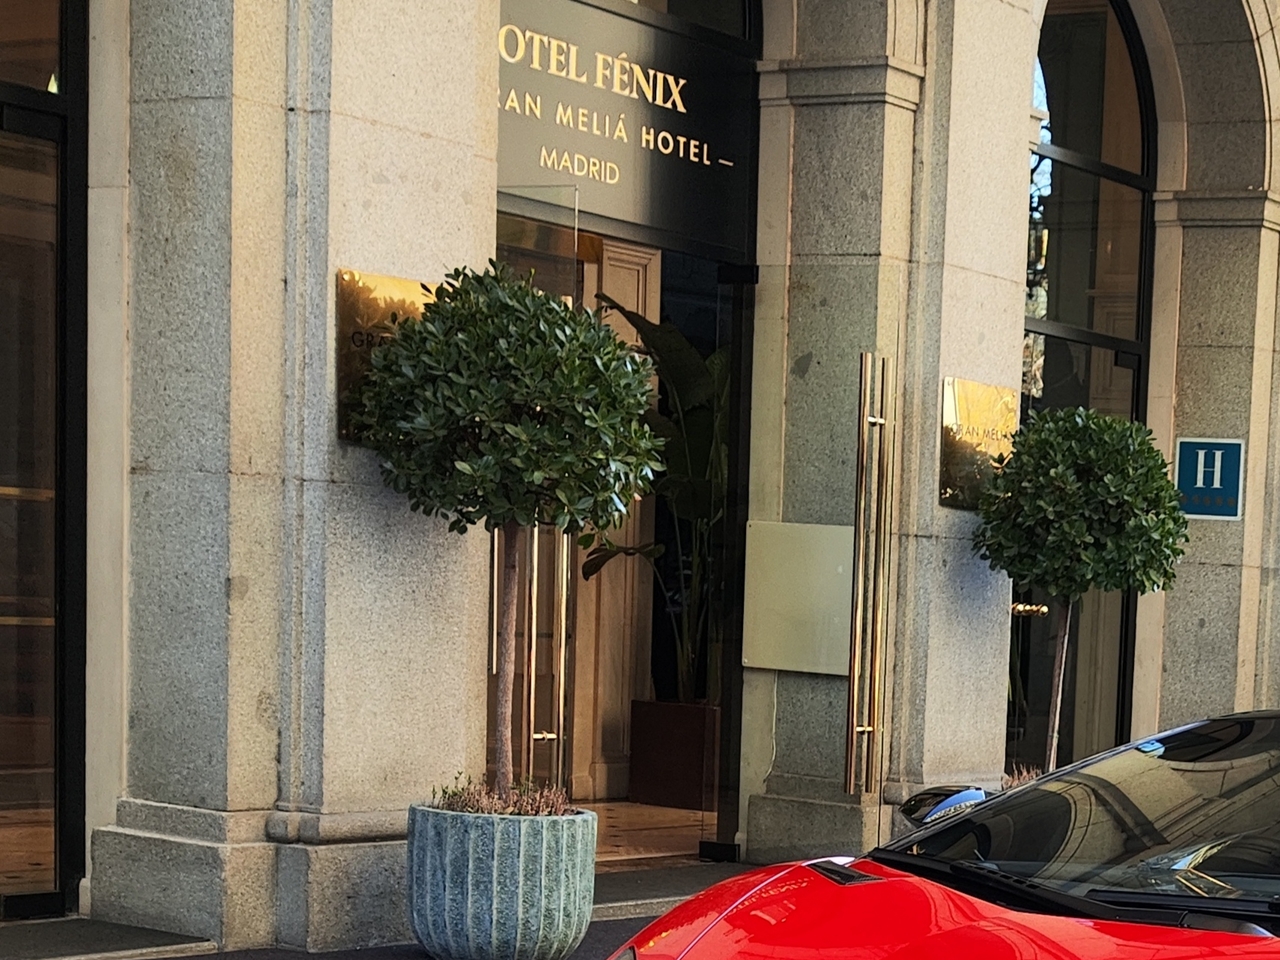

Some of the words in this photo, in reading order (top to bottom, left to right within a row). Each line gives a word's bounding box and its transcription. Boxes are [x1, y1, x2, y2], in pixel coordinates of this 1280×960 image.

[594, 52, 687, 113] FÉNIX
[497, 87, 541, 120] AN
[555, 101, 628, 144] MELIÁ
[640, 125, 711, 166] HOTEL
[539, 145, 620, 184] MADRID
[1194, 449, 1225, 489] H
